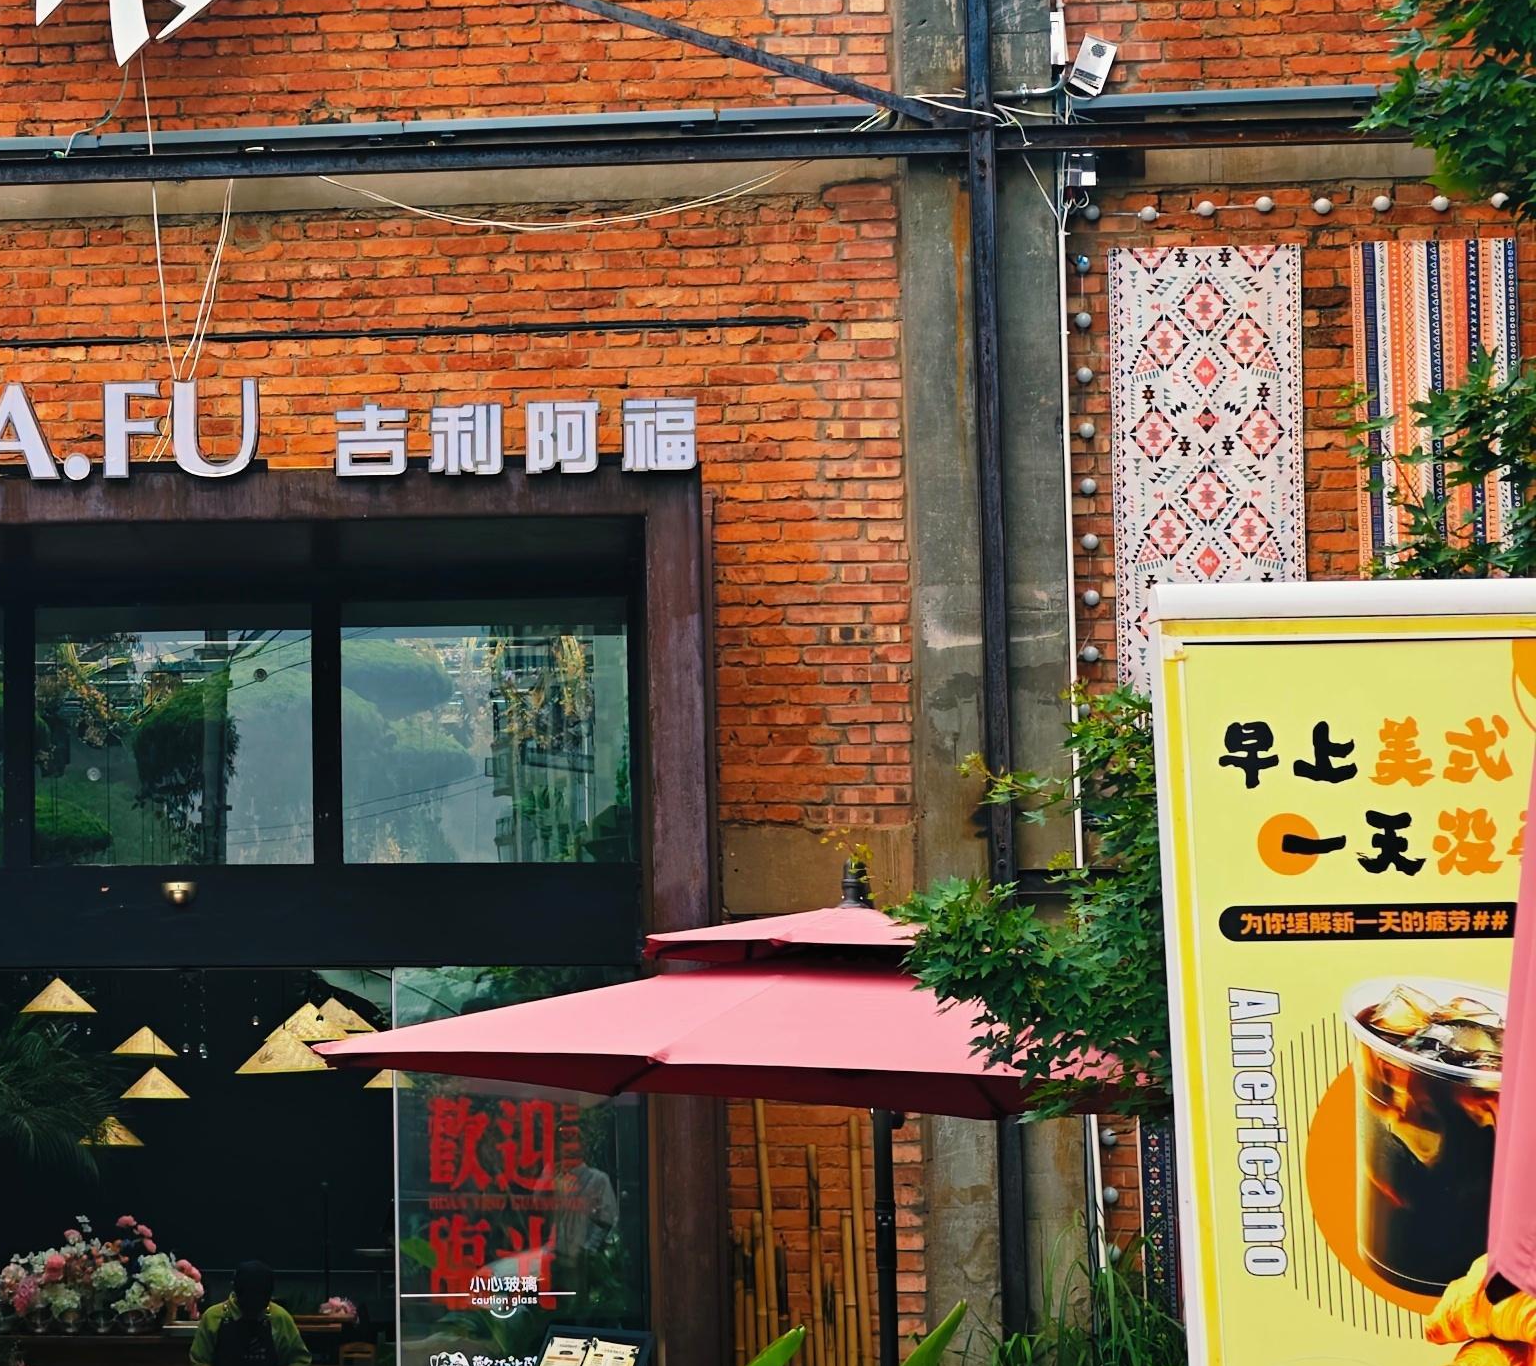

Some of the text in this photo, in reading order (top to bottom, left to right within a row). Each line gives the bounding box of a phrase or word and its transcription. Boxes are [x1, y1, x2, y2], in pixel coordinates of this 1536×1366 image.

[335, 397, 698, 477] 吉利阿福
[1219, 714, 1513, 789] 早上美式
[1227, 987, 1289, 1278] Americano
[470, 1276, 538, 1293] 小心玻璃
[471, 1295, 538, 1307] caution glass
